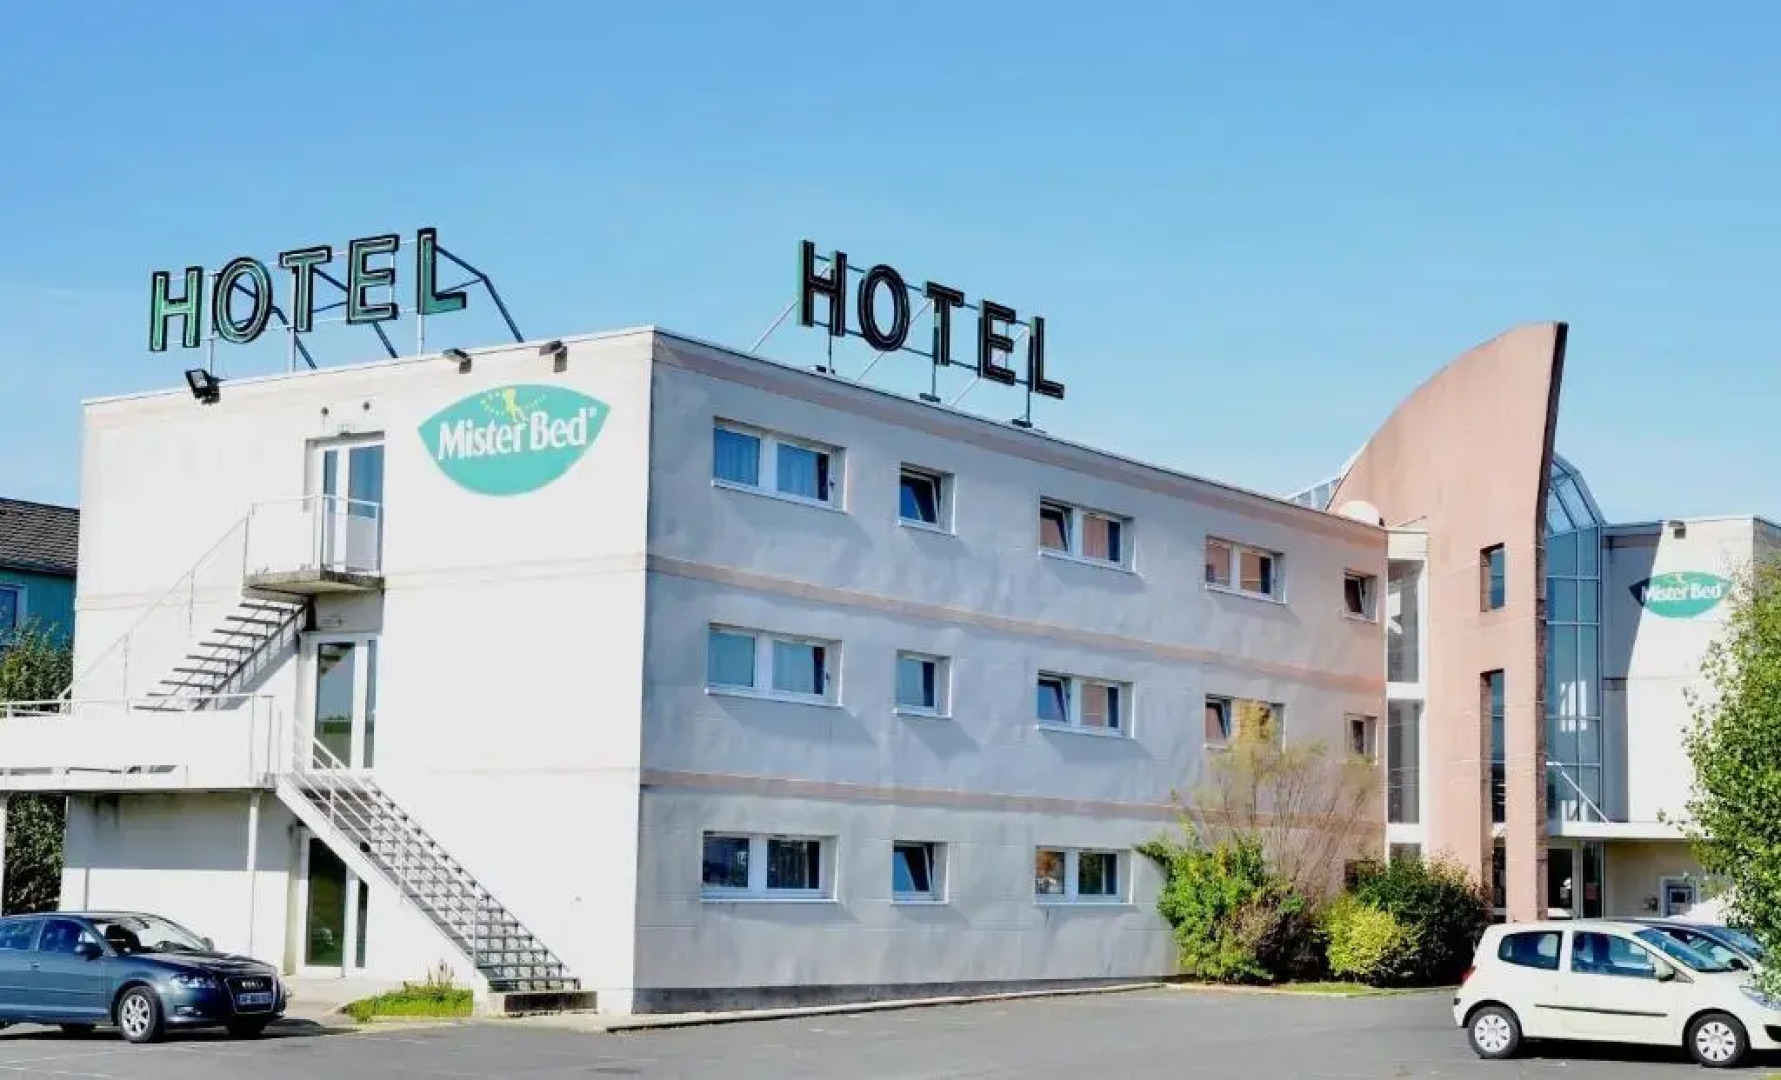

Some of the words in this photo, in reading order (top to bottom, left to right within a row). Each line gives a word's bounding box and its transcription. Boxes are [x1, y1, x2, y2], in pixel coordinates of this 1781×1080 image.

[149, 227, 467, 352] HOTEL
[797, 239, 1065, 400] HOTEL
[437, 418, 523, 460] Mister
[1690, 581, 1722, 599] Bed
